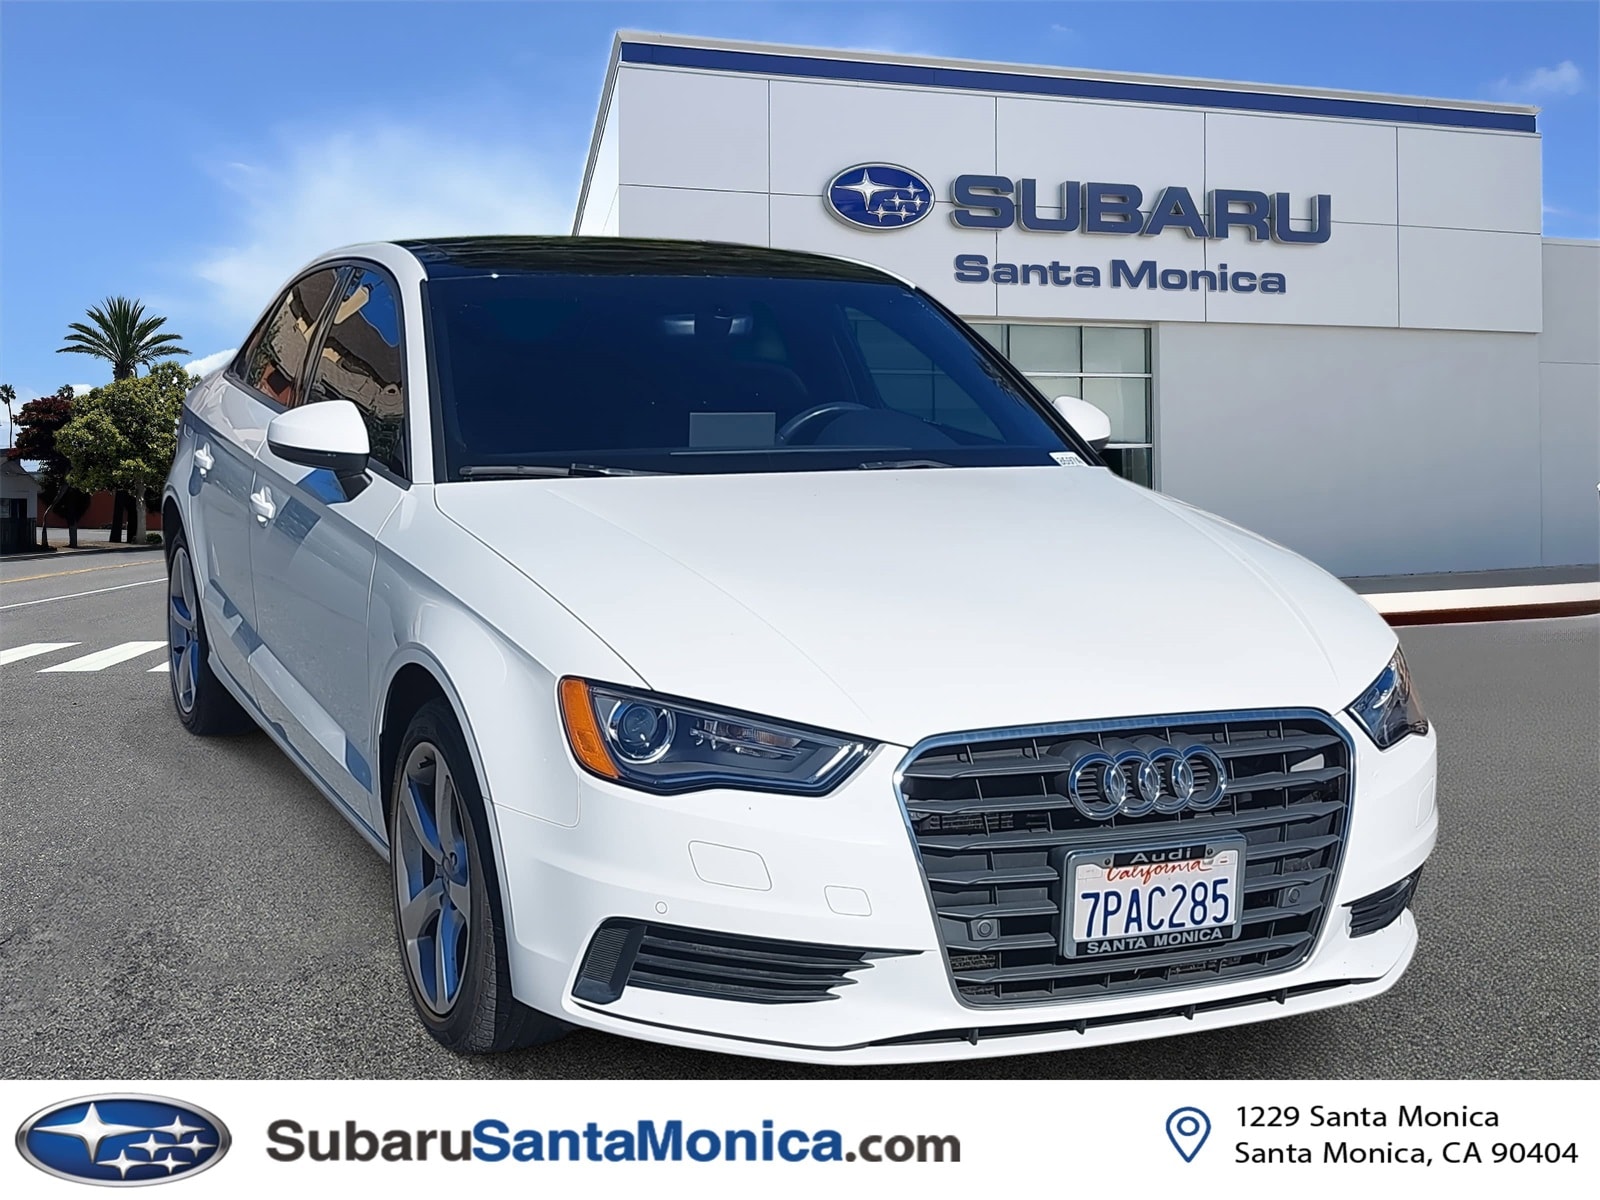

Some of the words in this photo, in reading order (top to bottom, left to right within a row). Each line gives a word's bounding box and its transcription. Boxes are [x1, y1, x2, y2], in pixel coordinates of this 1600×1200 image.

[949, 174, 1332, 244] SUBARU
[954, 253, 1101, 288] Santa
[1111, 259, 1287, 294] Monica
[1106, 859, 1213, 885] California
[1130, 847, 1191, 865] Audi
[1081, 878, 1229, 938] 7PAC285
[1087, 936, 1150, 954] SANTA
[1153, 927, 1223, 947] MONICA
